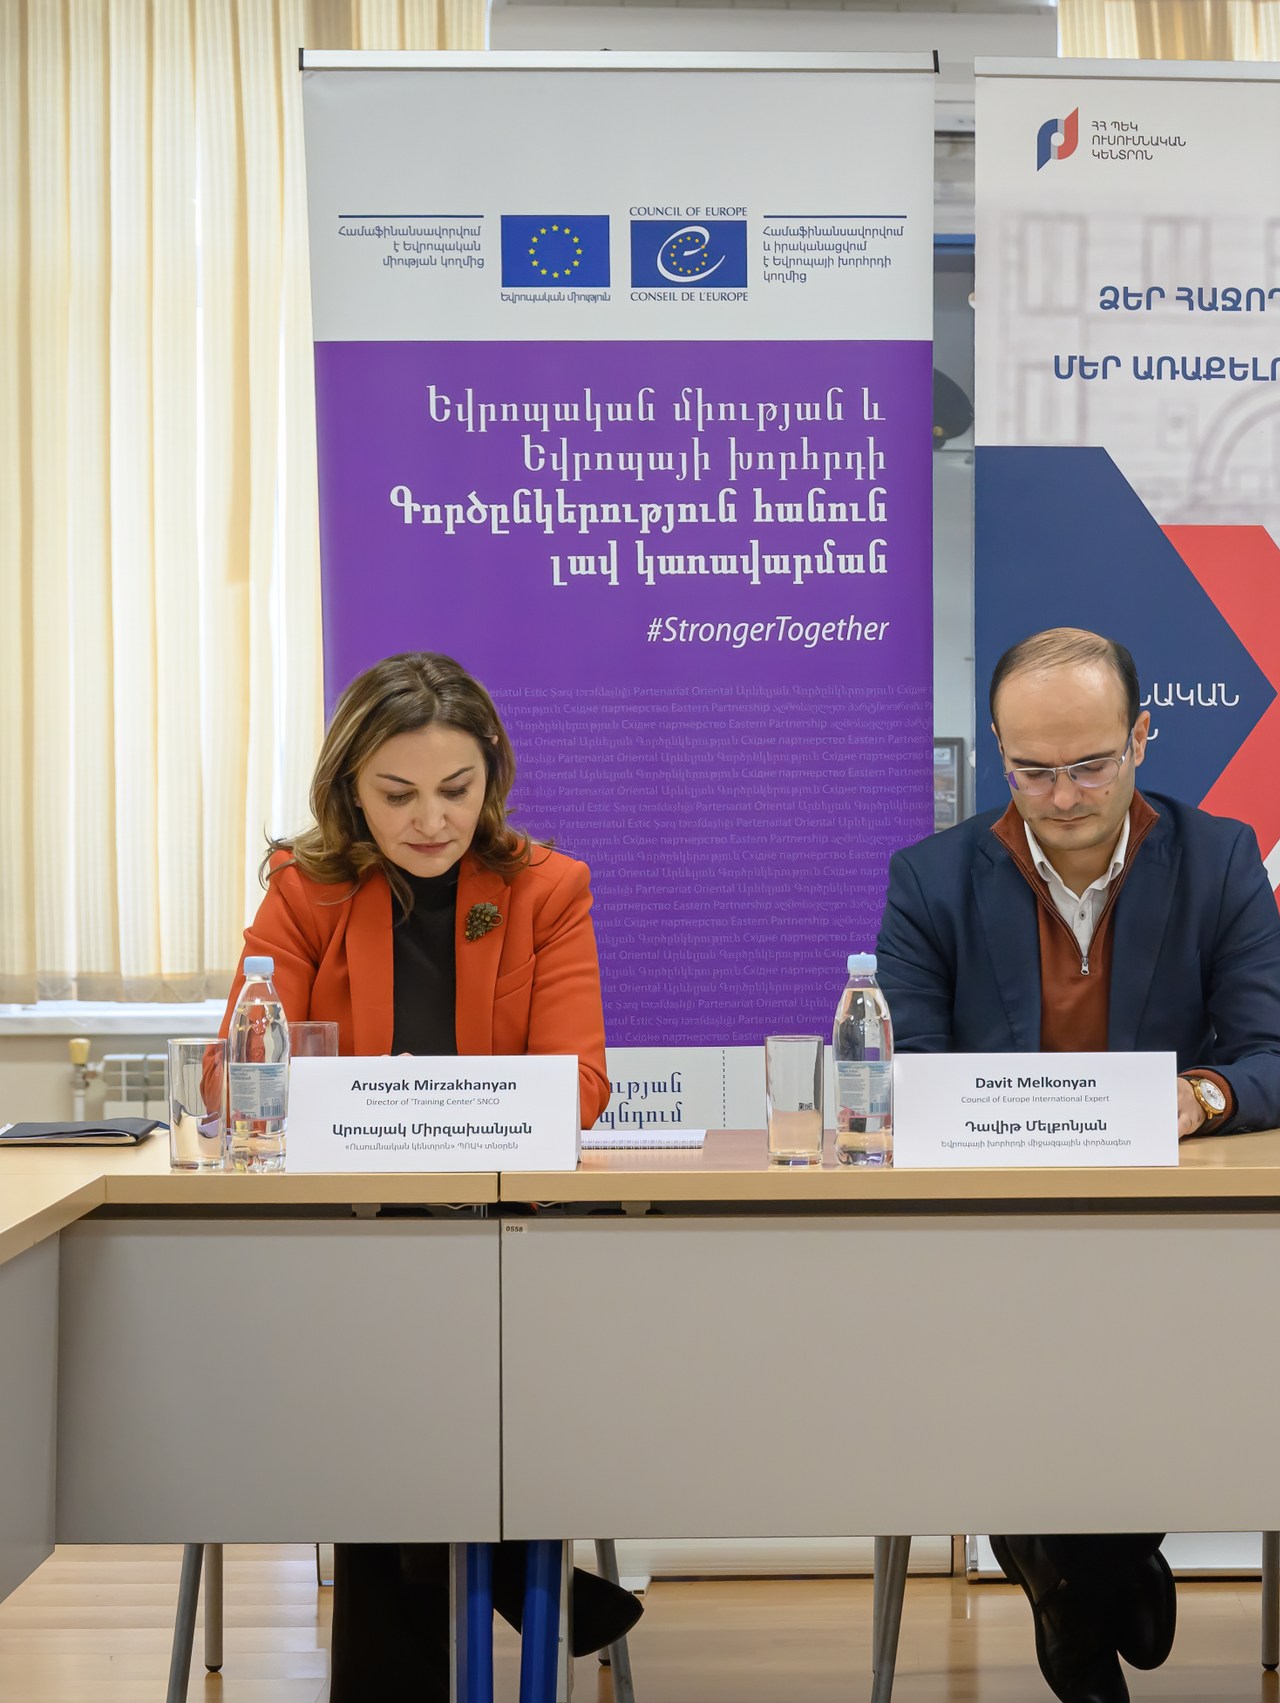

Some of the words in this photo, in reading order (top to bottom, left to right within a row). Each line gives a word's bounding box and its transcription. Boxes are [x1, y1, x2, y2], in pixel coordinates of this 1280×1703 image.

[1111, 121, 1138, 131] ՊԵԿ
[1092, 135, 1186, 146] ՈՒՍՈՒՄՆԱԿԱՆ
[1092, 149, 1153, 160] ԿԵՆՏՐՈՆ
[630, 207, 682, 216] COUNCIL
[686, 207, 700, 216] OF
[706, 207, 747, 216] EUROPE
[394, 241, 399, 252] է
[403, 240, 480, 253] Եվրոպական
[775, 241, 867, 253] իրականացվում
[383, 255, 437, 268] միության
[441, 256, 484, 269] կողմից
[764, 256, 769, 267] է
[773, 256, 834, 268] Եվրոպայի
[838, 256, 891, 268] խորհրդի
[764, 271, 806, 283] կողմից
[631, 292, 677, 301] CONSEIL
[682, 292, 695, 301] DE
[700, 292, 748, 301] L'EUROPE
[1100, 286, 1165, 310] ՁԵՐ
[1054, 355, 1121, 379] ՄԵՐ
[426, 385, 655, 435] Եվրոպական
[673, 387, 843, 431] միության
[522, 434, 710, 481] Եվրոպայի
[728, 437, 885, 480] խորհրդի
[390, 486, 737, 534] Գործընկերություն
[753, 487, 887, 522] հանուն
[550, 540, 619, 585] լավ
[635, 539, 887, 585] կառավարման
[647, 615, 889, 648] #StrongerTogether
[351, 1079, 409, 1093] Arusyak
[415, 1079, 516, 1092] Mirzakhanyan
[976, 1077, 1012, 1088] Davit
[1018, 1077, 1096, 1090] Melkonyan
[333, 1123, 406, 1137] Արուսյակ
[412, 1123, 531, 1137] Միրզախանյան
[965, 1121, 1021, 1134] Դավիթ
[1026, 1120, 1106, 1133] Մելքոնյան
